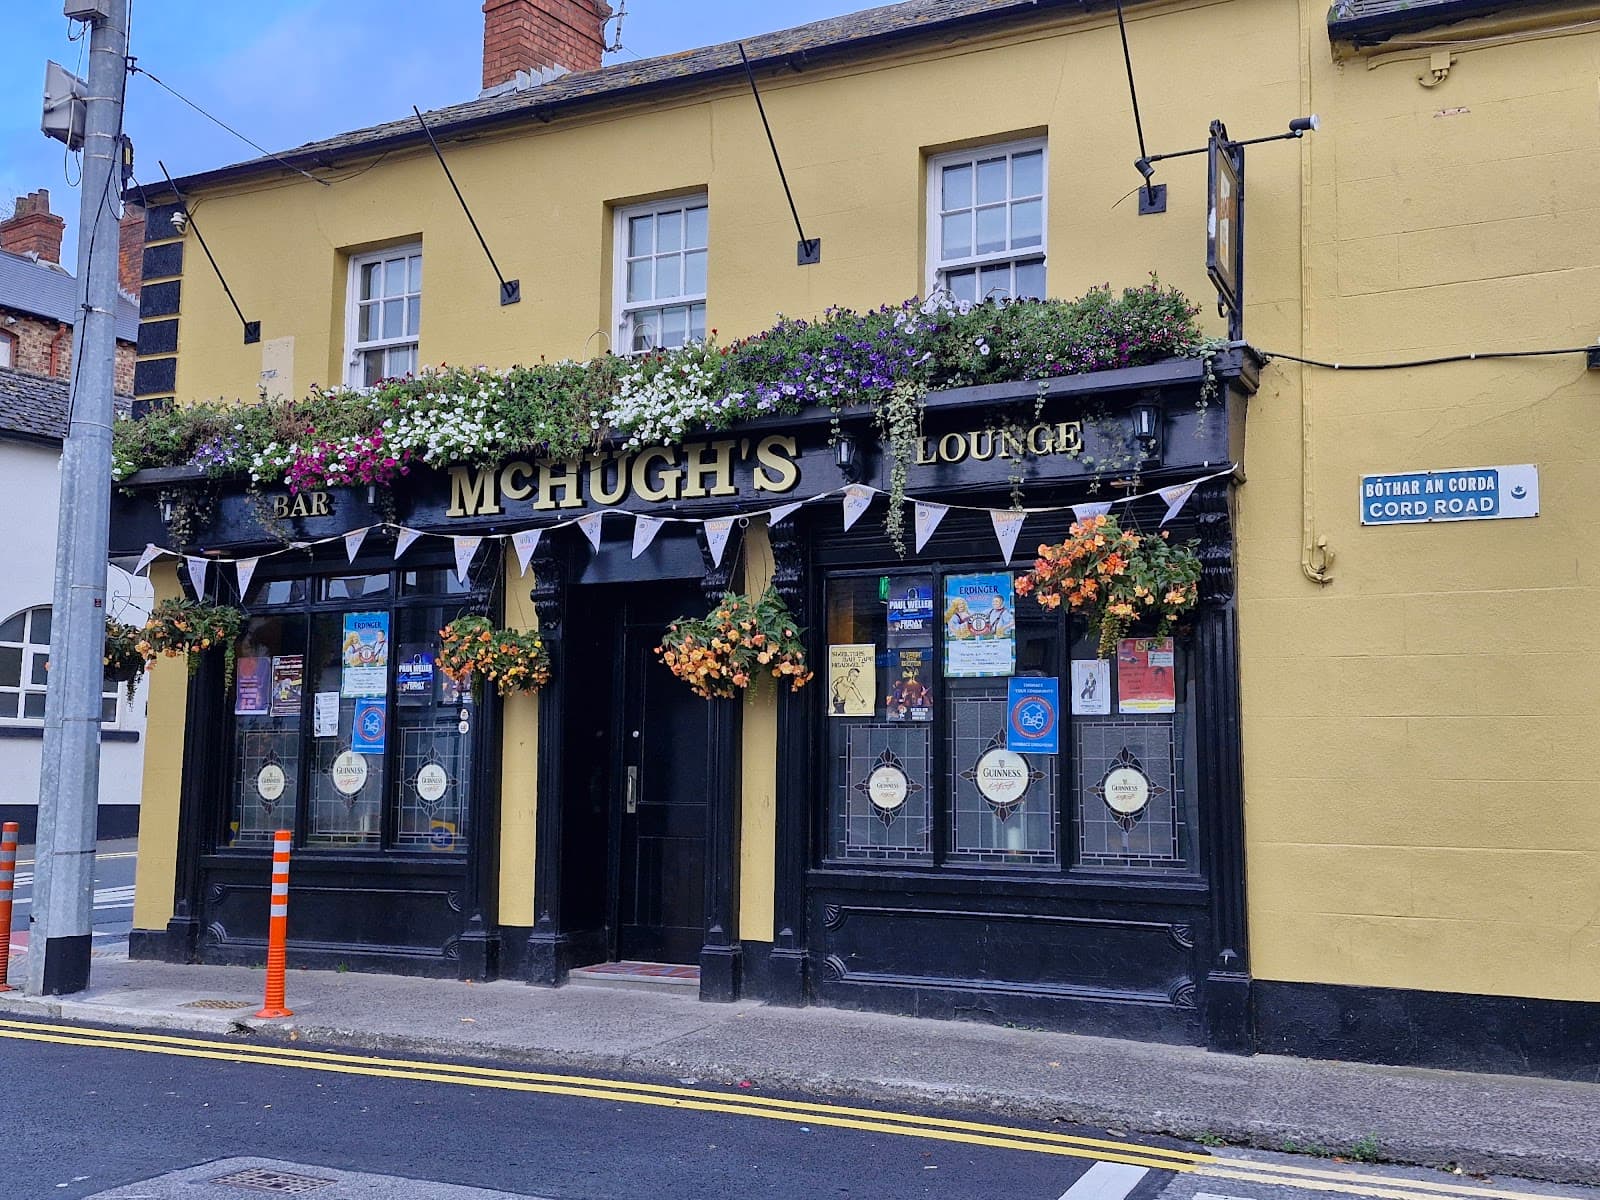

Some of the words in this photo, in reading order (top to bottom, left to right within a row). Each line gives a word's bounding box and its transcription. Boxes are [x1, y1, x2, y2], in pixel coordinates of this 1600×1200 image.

[914, 421, 1082, 465] LOUNGE
[1366, 479, 1419, 497] BÓTHAR
[1425, 479, 1444, 493] AN
[1449, 476, 1495, 492] CORDA
[273, 491, 329, 518] BAR
[1369, 501, 1427, 517] CORD
[1434, 497, 1494, 514] ROAD
[959, 585, 999, 595] ERDINGER
[889, 600, 906, 609] PAUL
[907, 600, 933, 609] WELLER
[354, 621, 381, 630] ERDINGER
[336, 767, 364, 775] GUINNESS
[982, 767, 1022, 778] GUINNESS
